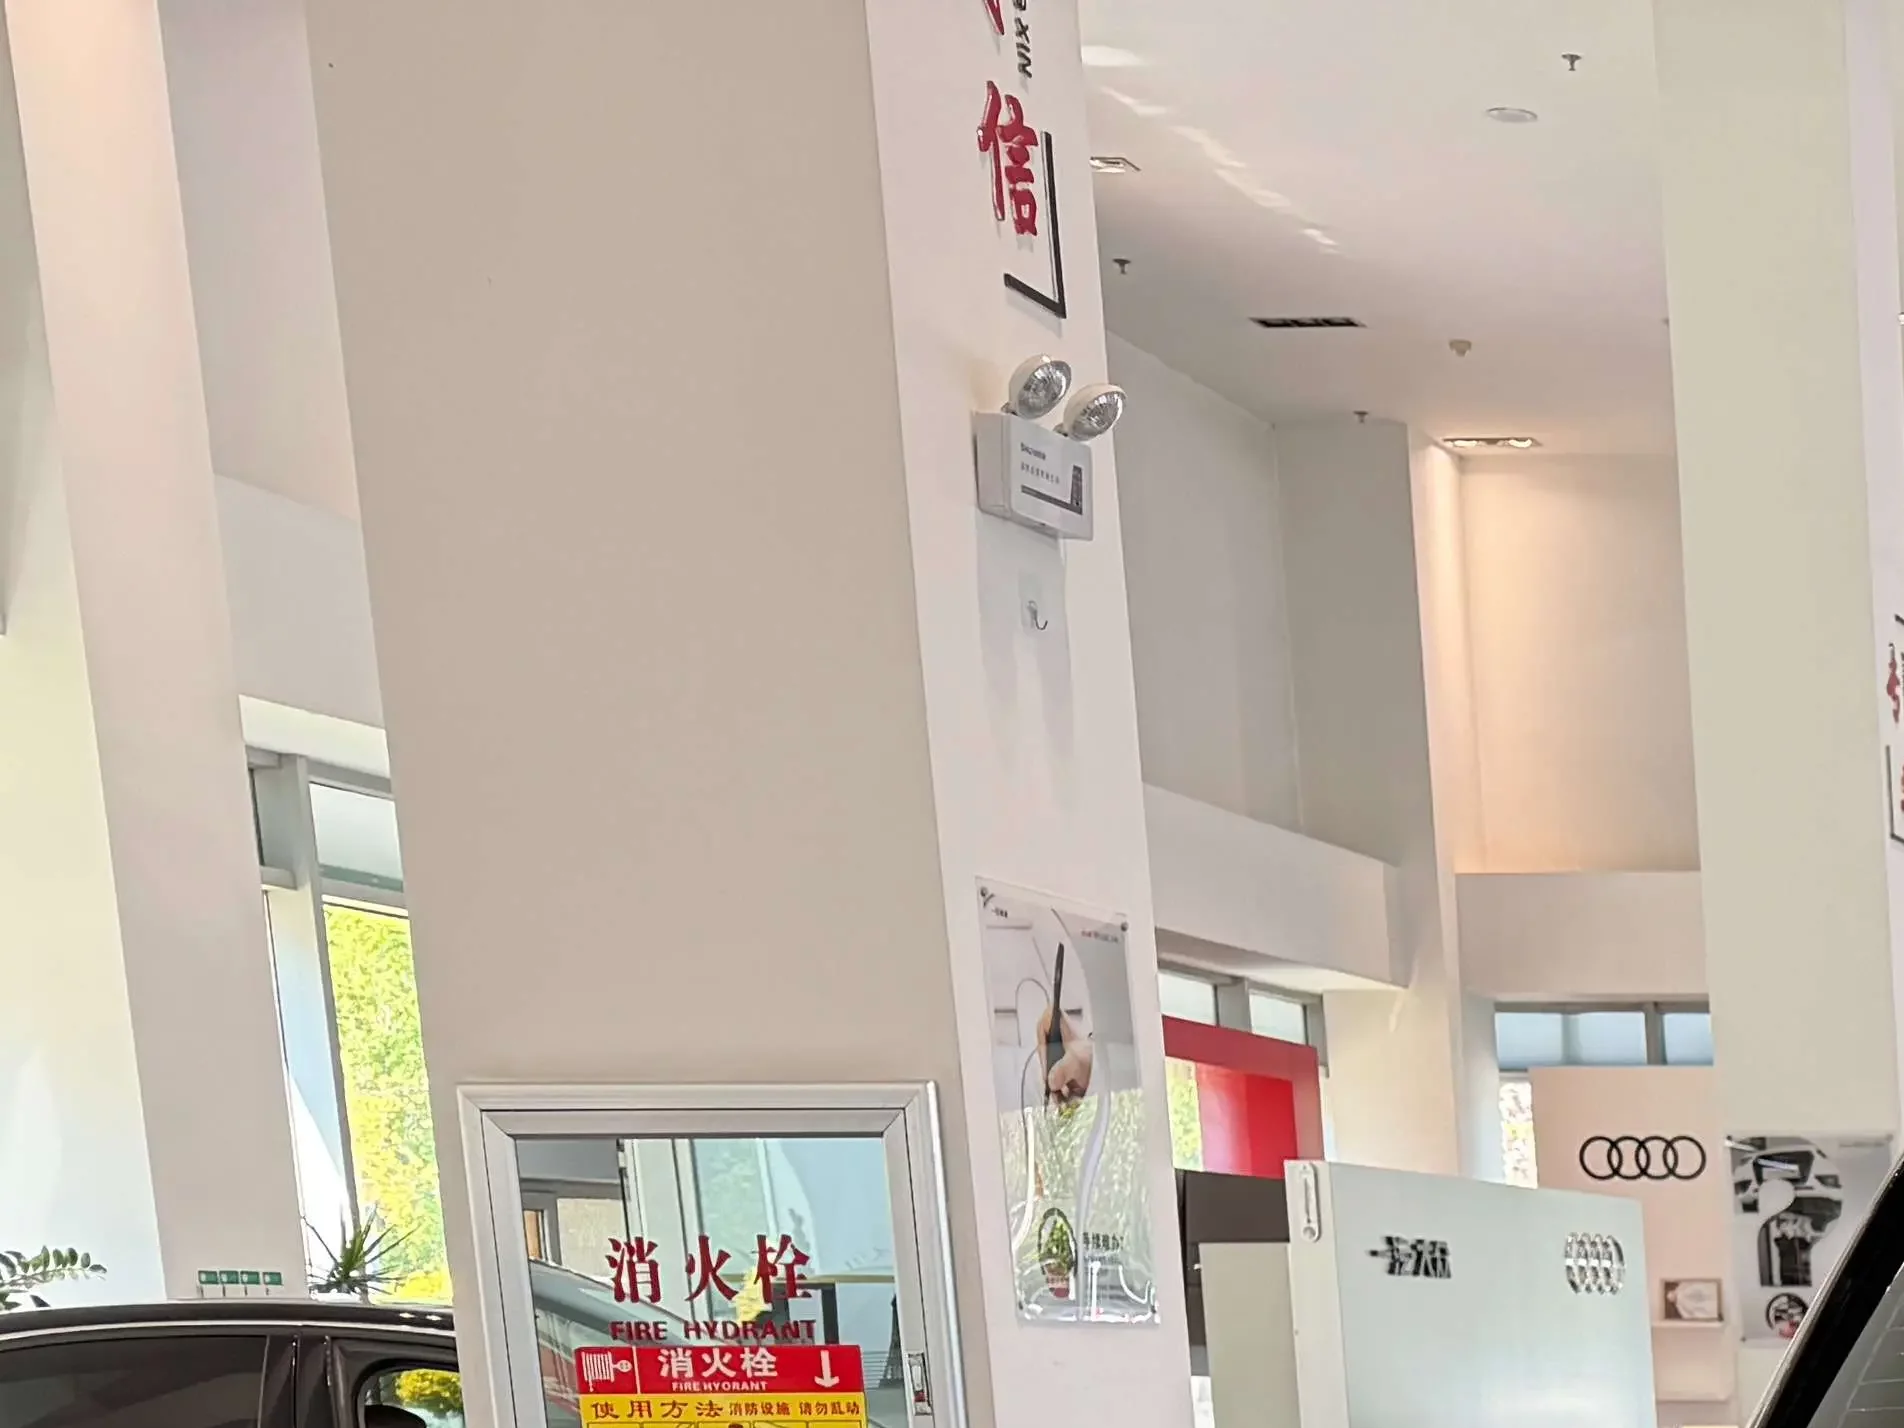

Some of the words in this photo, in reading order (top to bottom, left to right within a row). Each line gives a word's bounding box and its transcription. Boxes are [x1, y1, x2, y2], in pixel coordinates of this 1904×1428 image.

[605, 1234, 811, 1303] 消火栓
[609, 1320, 668, 1341] FIRE
[683, 1319, 817, 1340] HYDRANT
[658, 1347, 778, 1378] 消火栓
[672, 1381, 700, 1392] FIRE
[591, 1399, 723, 1419] 使用方法
[729, 1400, 791, 1417] 消防设施
[799, 1401, 860, 1416] 请勿乱动
